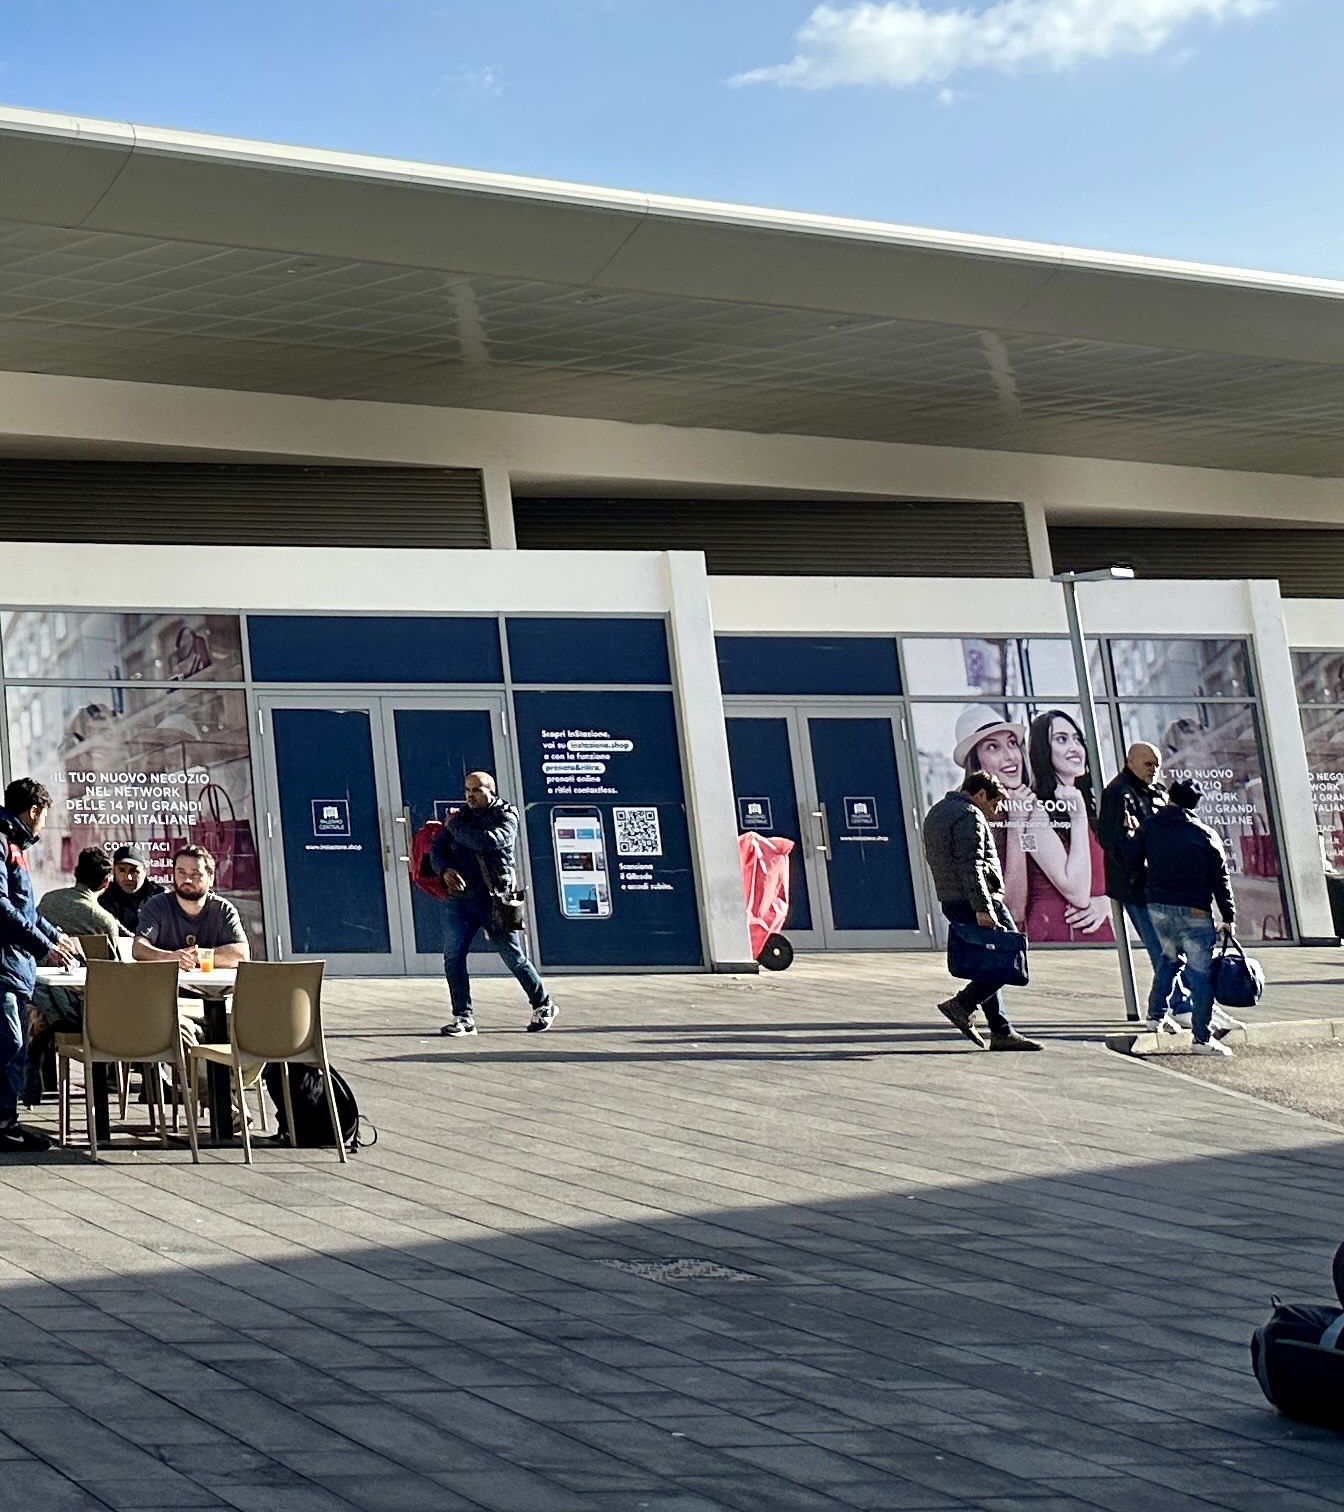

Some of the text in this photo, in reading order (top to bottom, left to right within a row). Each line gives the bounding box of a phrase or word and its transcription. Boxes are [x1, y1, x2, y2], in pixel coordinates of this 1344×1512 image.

[54, 772, 210, 785] IL TUO NUOVO NEGOZIO
[1169, 769, 1192, 779] TUO
[1195, 769, 1234, 779] NUOVO
[1315, 772, 1344, 781] NEGO
[86, 786, 180, 798] NEL NETWORK
[1311, 783, 1340, 792] WORK
[1205, 792, 1239, 802] WORK
[1318, 792, 1344, 802] GRAN
[66, 798, 202, 812] DELLE 14 PIÙ GRANDI
[1036, 799, 1078, 812] SOON
[1215, 804, 1257, 814] GRANDI
[1313, 804, 1344, 812] TALIAN
[73, 813, 197, 826] STAZIONI ITALIANE
